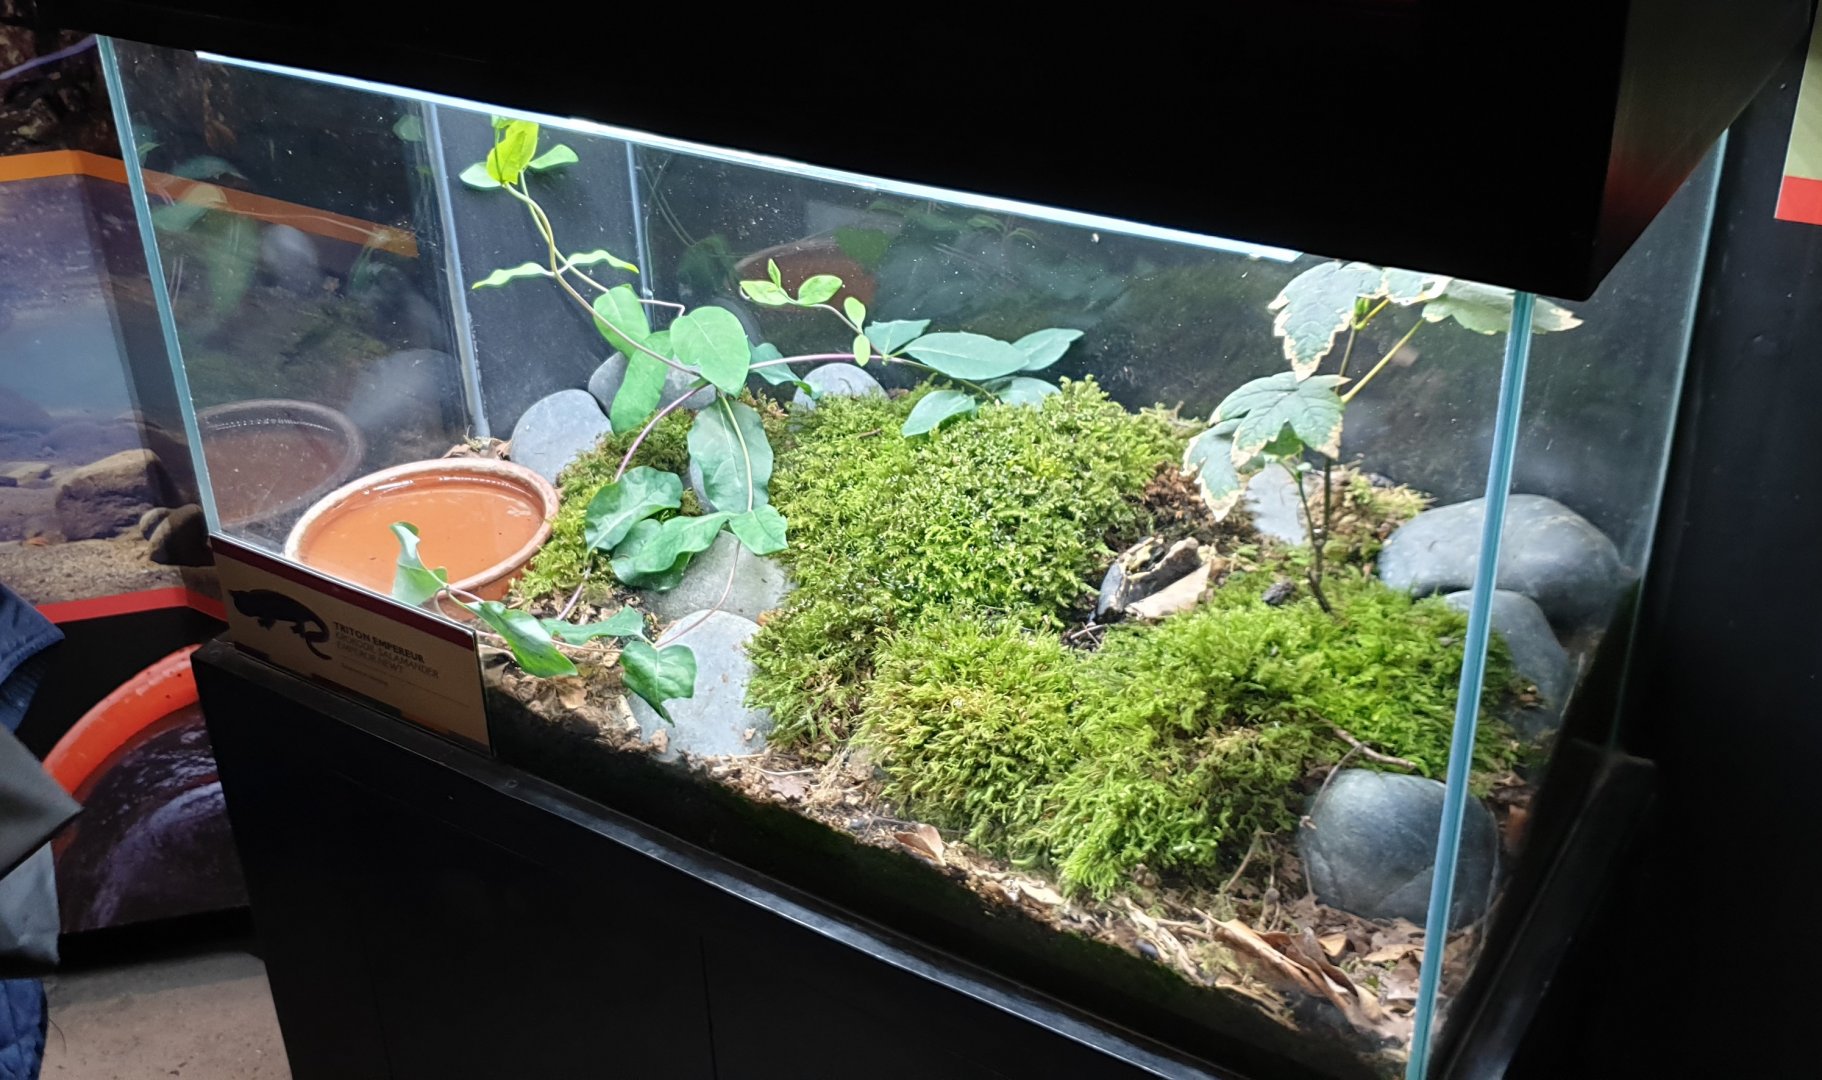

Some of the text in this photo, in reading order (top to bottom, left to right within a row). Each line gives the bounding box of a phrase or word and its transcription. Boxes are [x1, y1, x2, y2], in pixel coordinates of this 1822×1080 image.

[333, 620, 425, 664] TRITON EMPEREUR
[378, 647, 439, 680] SALAMANDER
